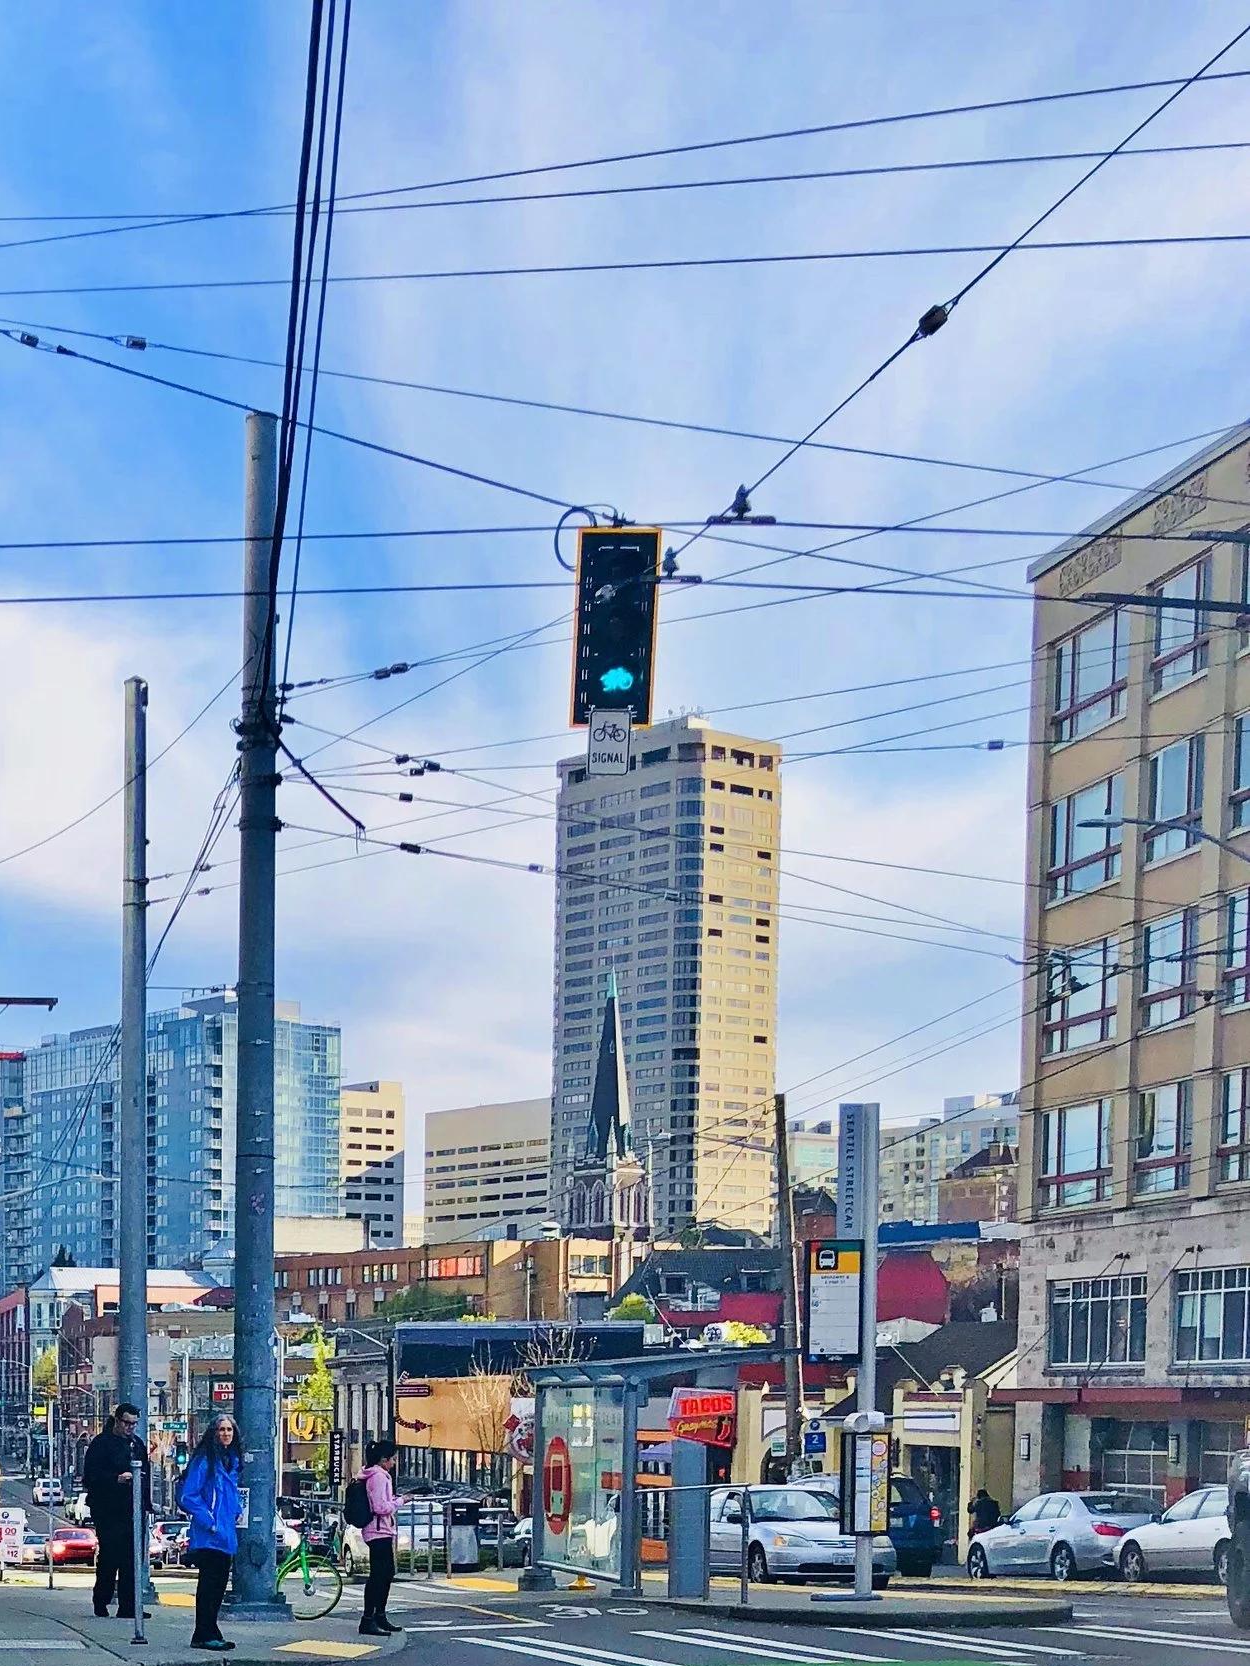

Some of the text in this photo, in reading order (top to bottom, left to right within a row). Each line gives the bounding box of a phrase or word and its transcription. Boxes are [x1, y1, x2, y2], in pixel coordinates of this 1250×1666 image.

[592, 752, 625, 763] SIGNAL
[845, 1114, 854, 1229] SEATTLE STREETCAR
[679, 1395, 734, 1416] TACOS
[812, 1434, 819, 1444] 2
[333, 1433, 341, 1483] STARBUCKS
